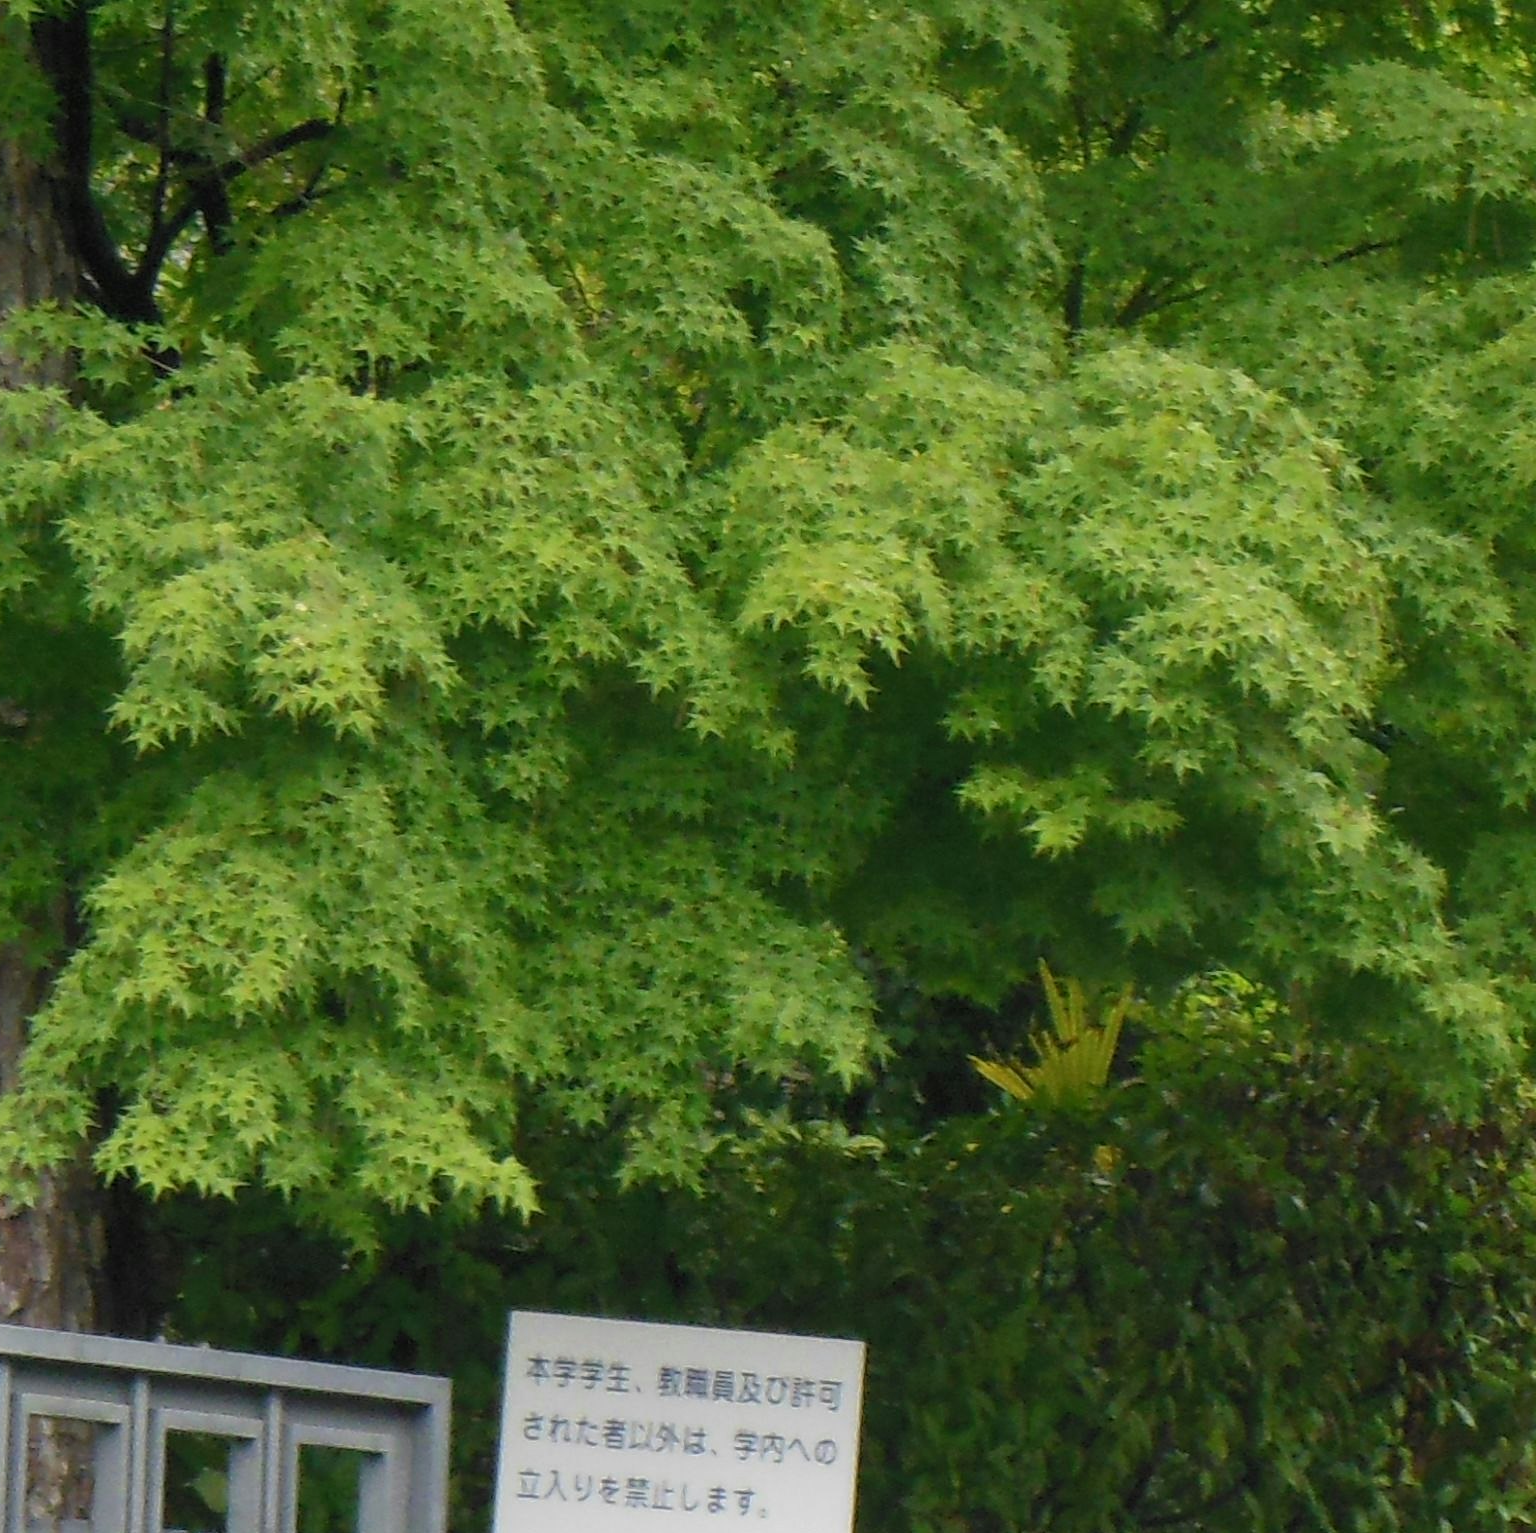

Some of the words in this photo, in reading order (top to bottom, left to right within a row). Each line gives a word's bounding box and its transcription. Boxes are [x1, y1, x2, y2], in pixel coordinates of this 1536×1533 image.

[522, 1413, 837, 1464] された者以外は、学内への
[517, 1469, 768, 1518] 立入りを禁止します。
